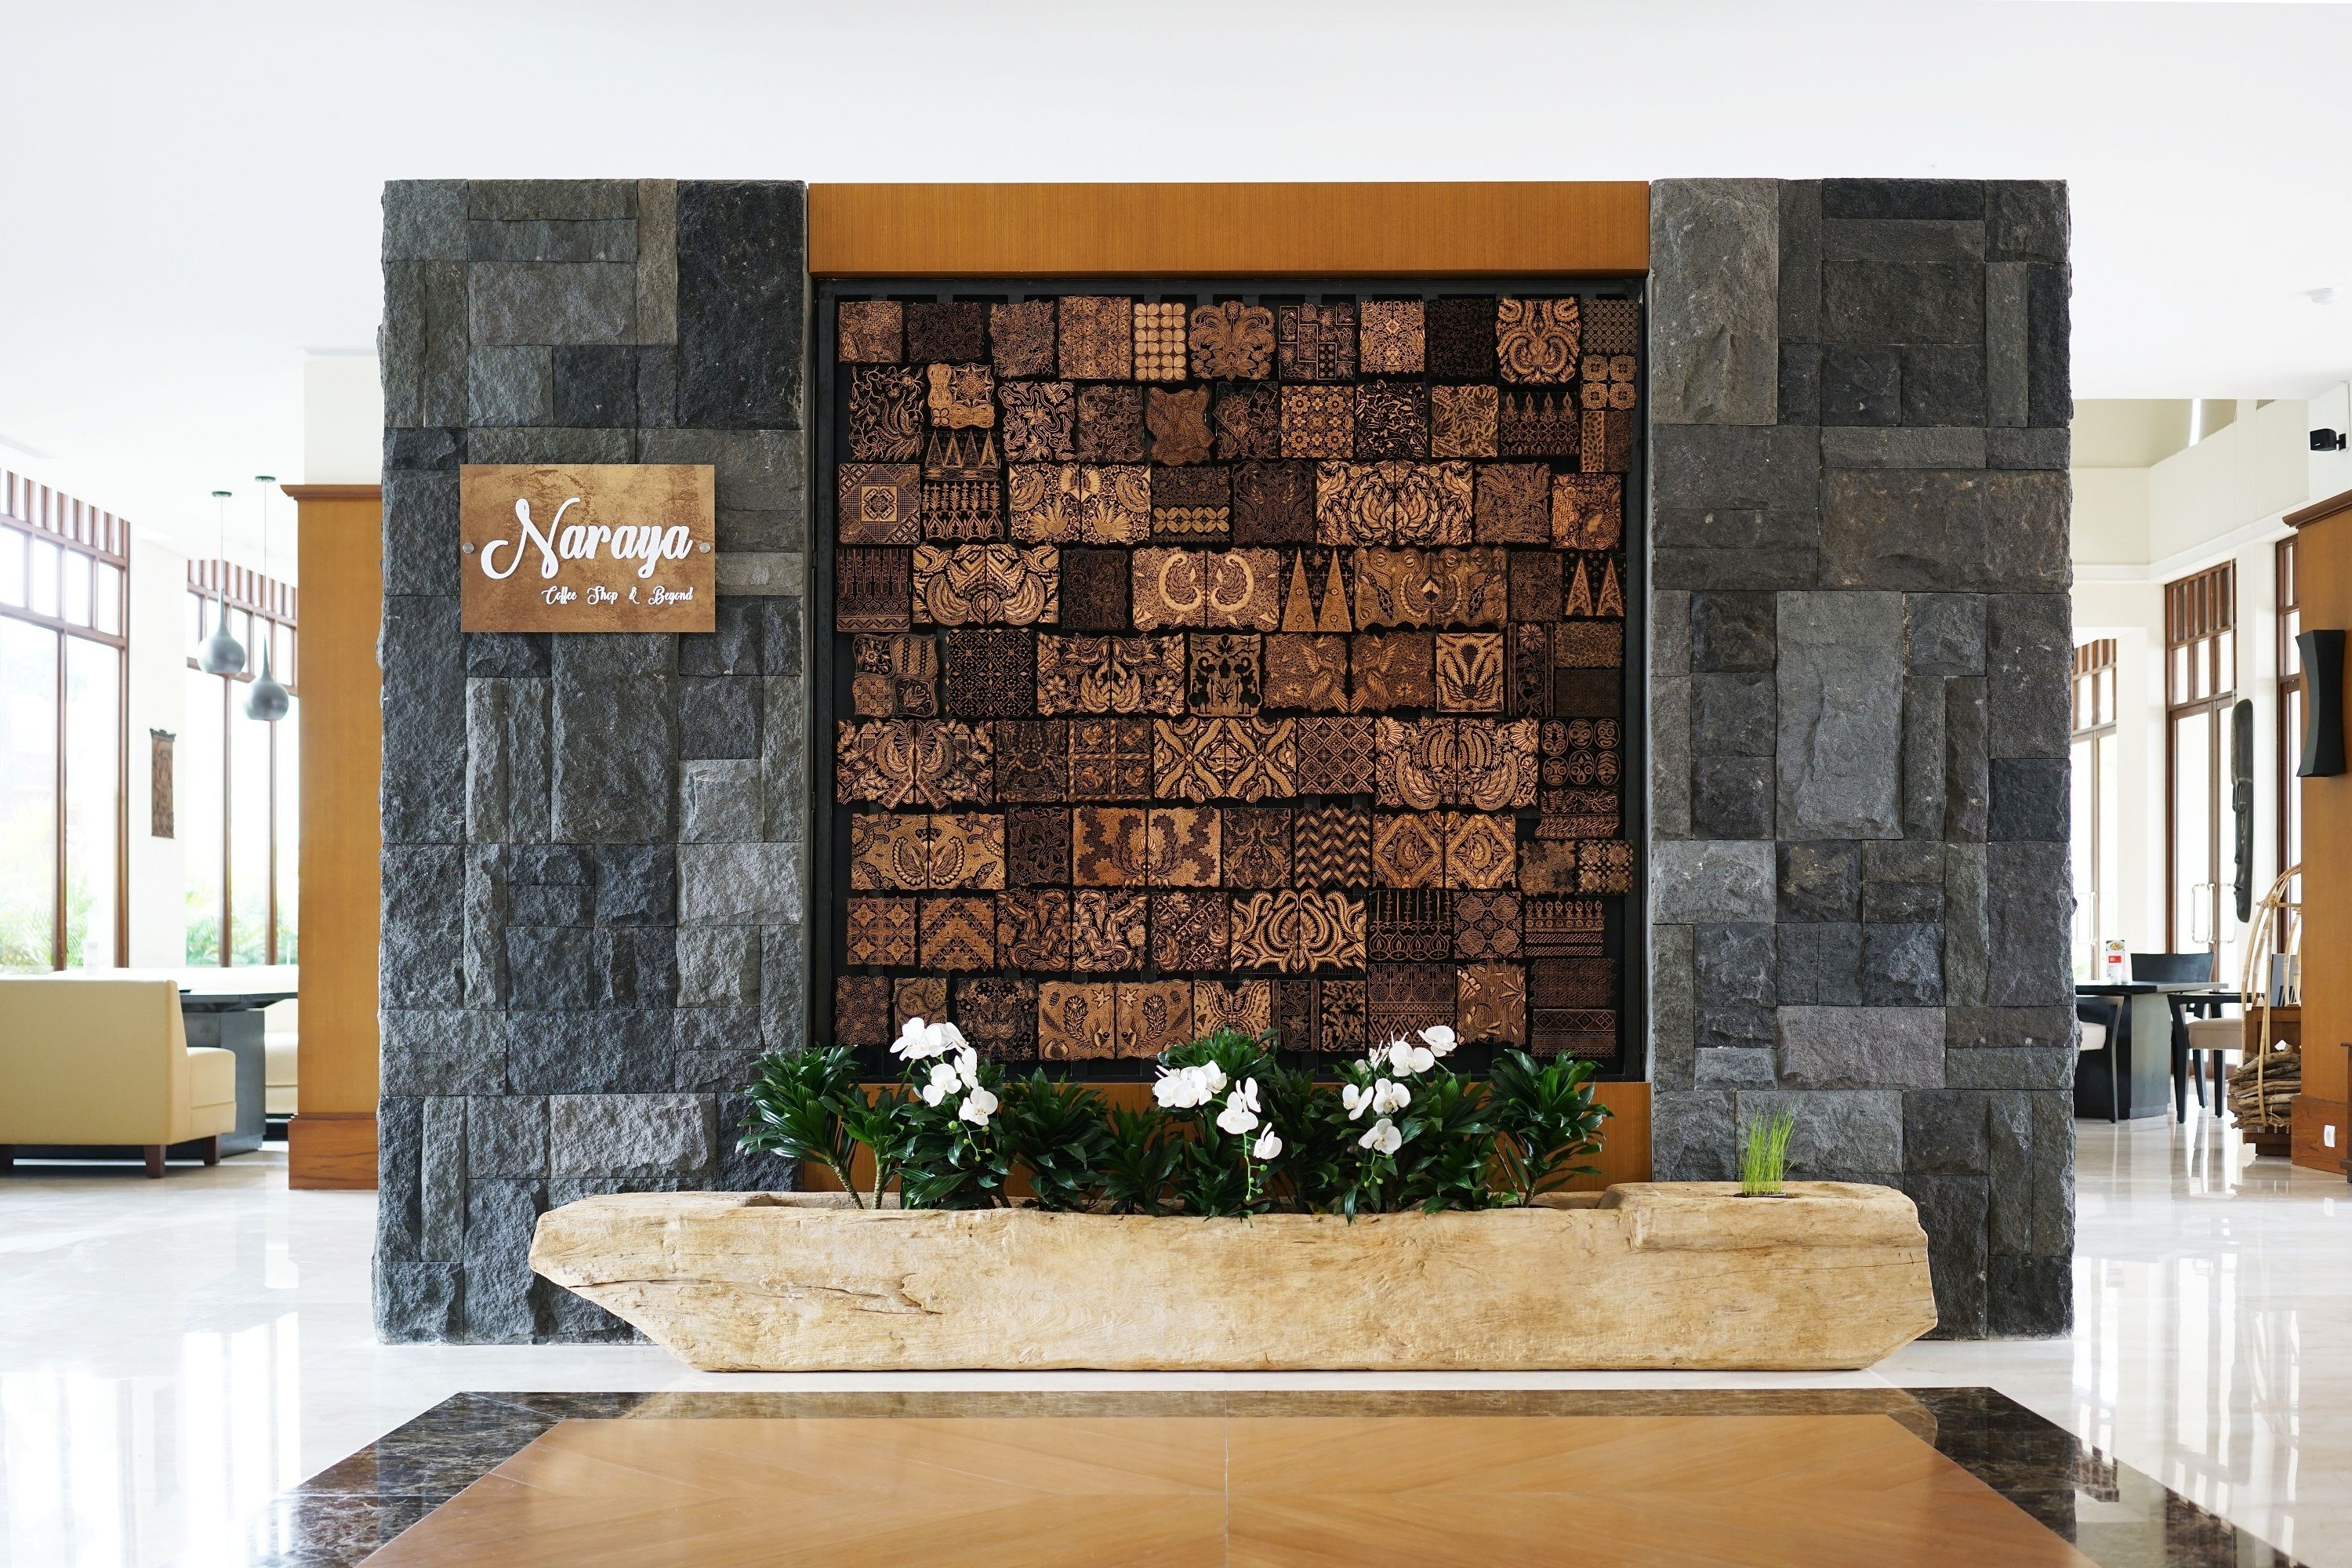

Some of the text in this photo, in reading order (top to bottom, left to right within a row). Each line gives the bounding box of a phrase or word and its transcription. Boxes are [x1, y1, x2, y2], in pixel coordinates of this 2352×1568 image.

[481, 497, 694, 579] Naraya
[541, 585, 694, 605] Coffee Shop & Beyond
